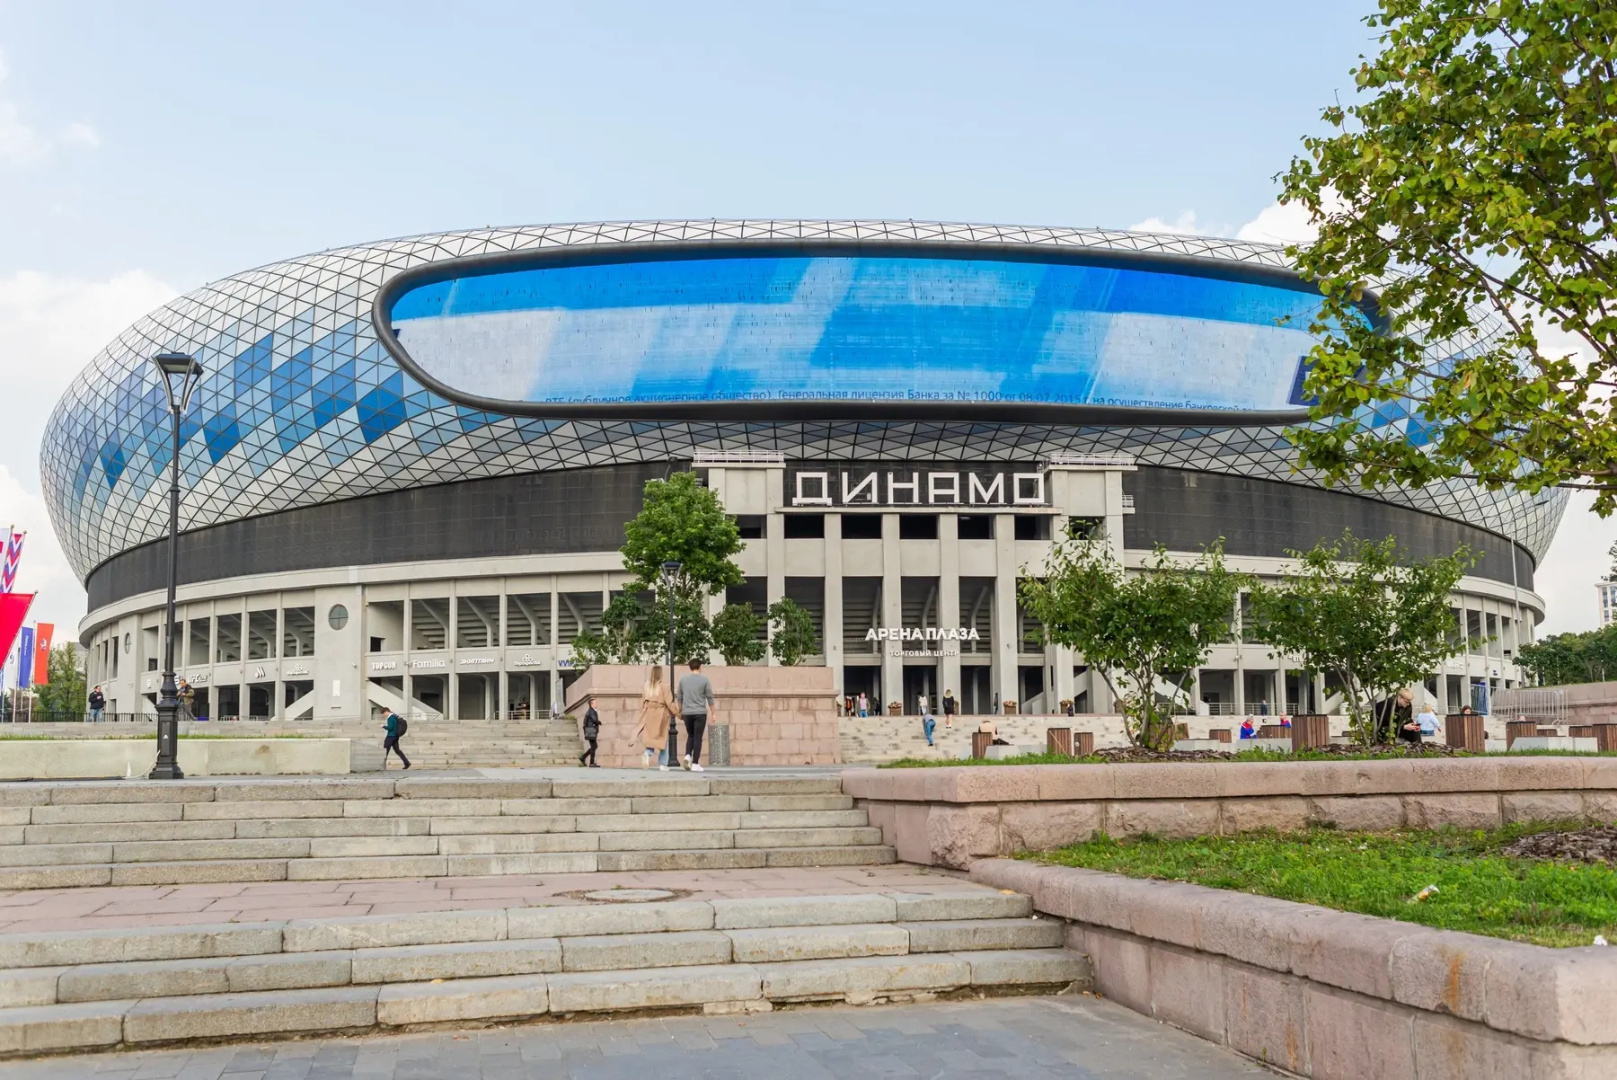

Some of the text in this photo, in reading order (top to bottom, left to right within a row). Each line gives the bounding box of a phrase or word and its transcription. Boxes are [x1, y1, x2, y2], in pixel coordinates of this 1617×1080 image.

[779, 389, 847, 400] Генеральная
[851, 390, 904, 400] лицензия
[907, 389, 940, 400] Банка
[943, 391, 954, 400] за
[957, 391, 970, 400] №
[974, 391, 1002, 401] 1000
[1005, 393, 1016, 401] от
[1092, 396, 1105, 404] на
[792, 472, 1046, 506] ДИНАМО
[865, 627, 980, 641] АРЕНА ПЛАЗА
[889, 649, 959, 658] ТОРГОВЫЙ ЦЕНТР
